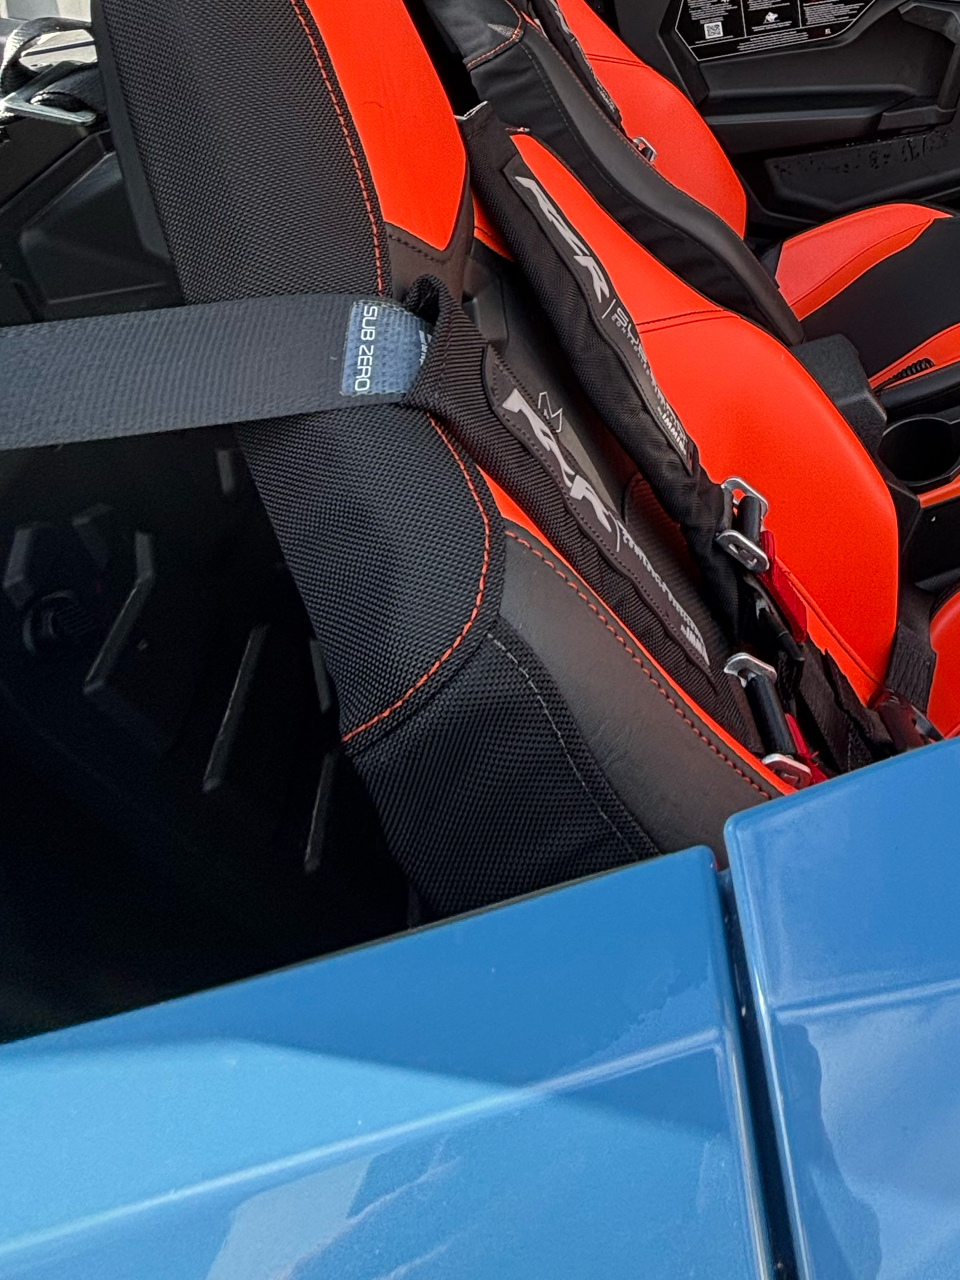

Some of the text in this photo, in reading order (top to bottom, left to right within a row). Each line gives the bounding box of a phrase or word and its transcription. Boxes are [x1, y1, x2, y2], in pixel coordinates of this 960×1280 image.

[515, 176, 610, 304] RZR
[354, 305, 378, 392] SUB ZERO
